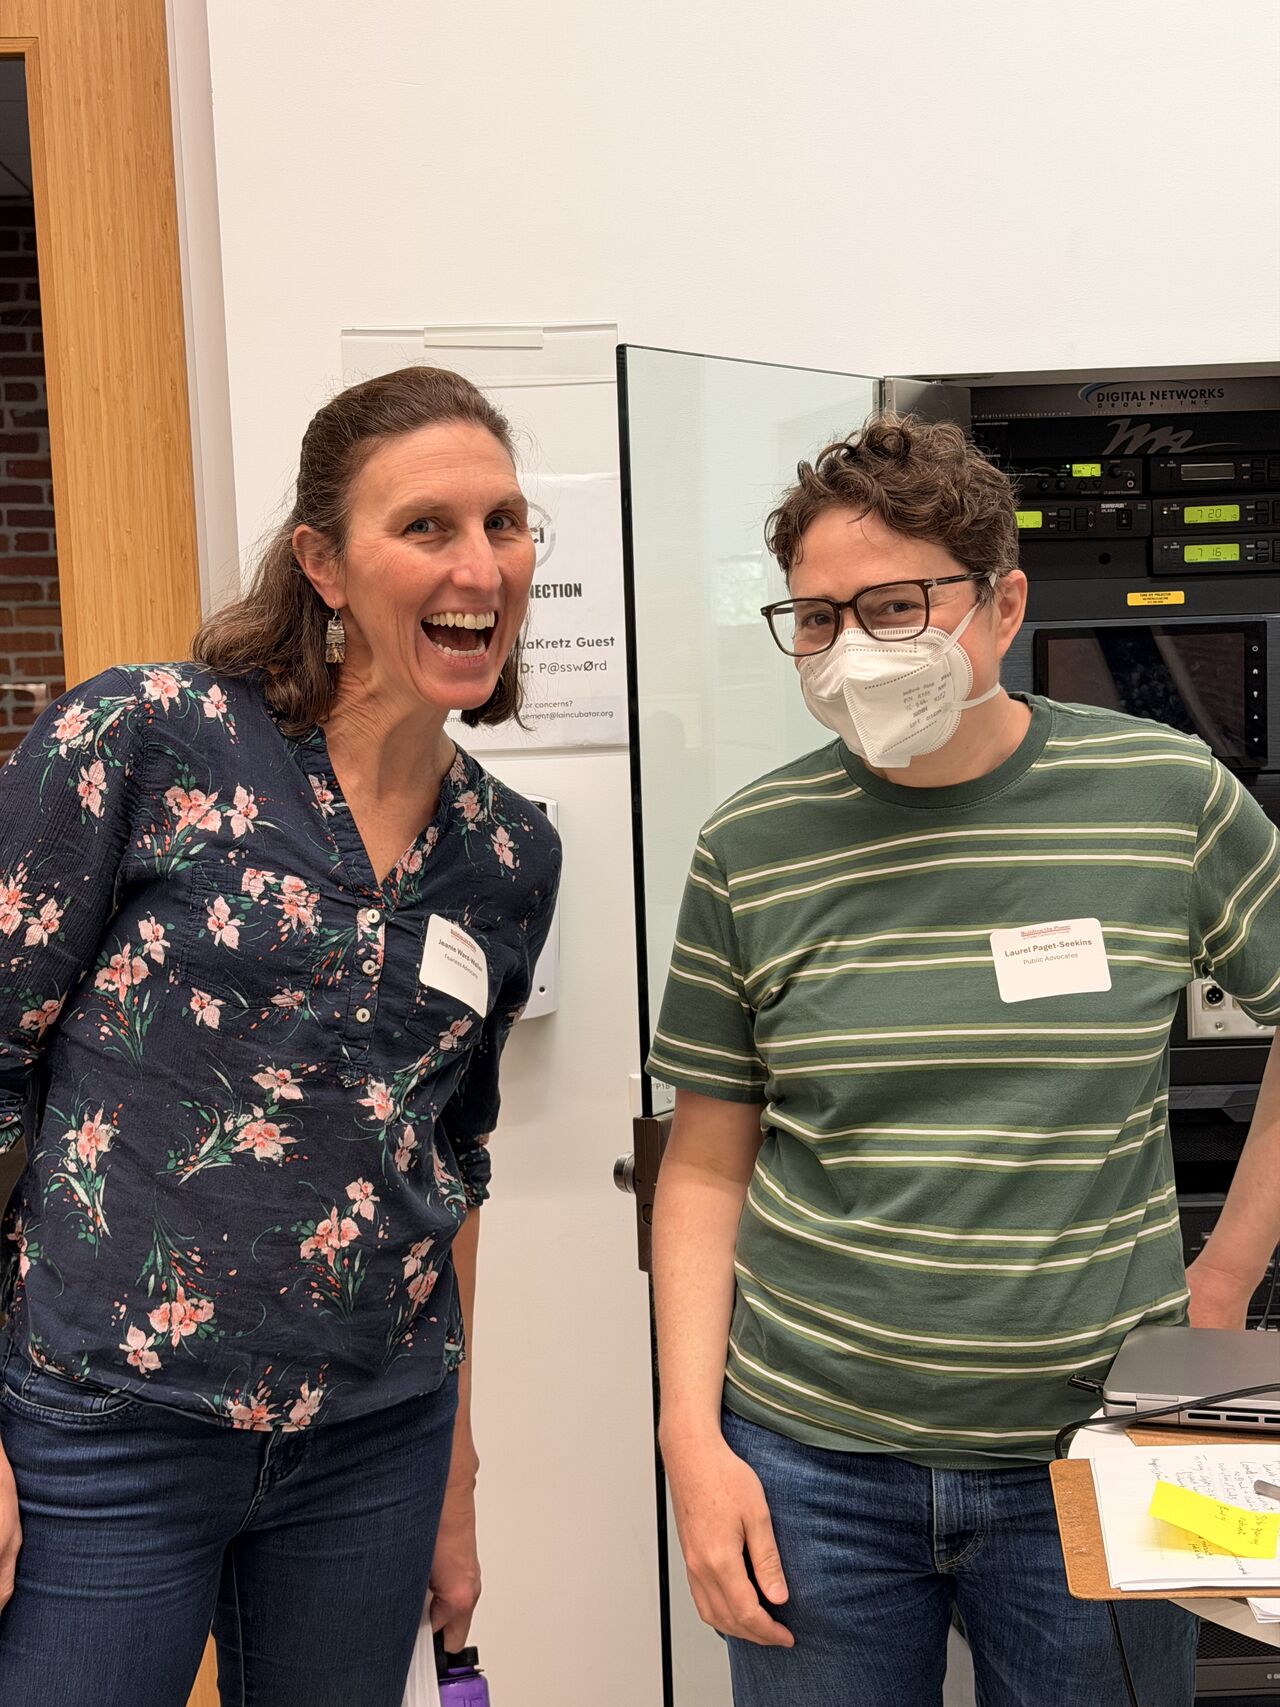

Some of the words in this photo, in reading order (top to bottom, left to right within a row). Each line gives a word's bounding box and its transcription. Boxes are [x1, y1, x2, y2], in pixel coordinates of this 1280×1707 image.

[1097, 391, 1146, 402] DIGITAL
[1150, 388, 1225, 400] NETWORKS
[1207, 508, 1222, 519] 20
[1211, 547, 1222, 557] 16
[576, 636, 615, 648] Guest
[534, 700, 573, 709] concerns?
[1004, 946, 1032, 957] Laurel
[1032, 938, 1093, 952] Paget-Seekins
[1023, 957, 1044, 965] Public
[1044, 952, 1079, 962] Advocates
